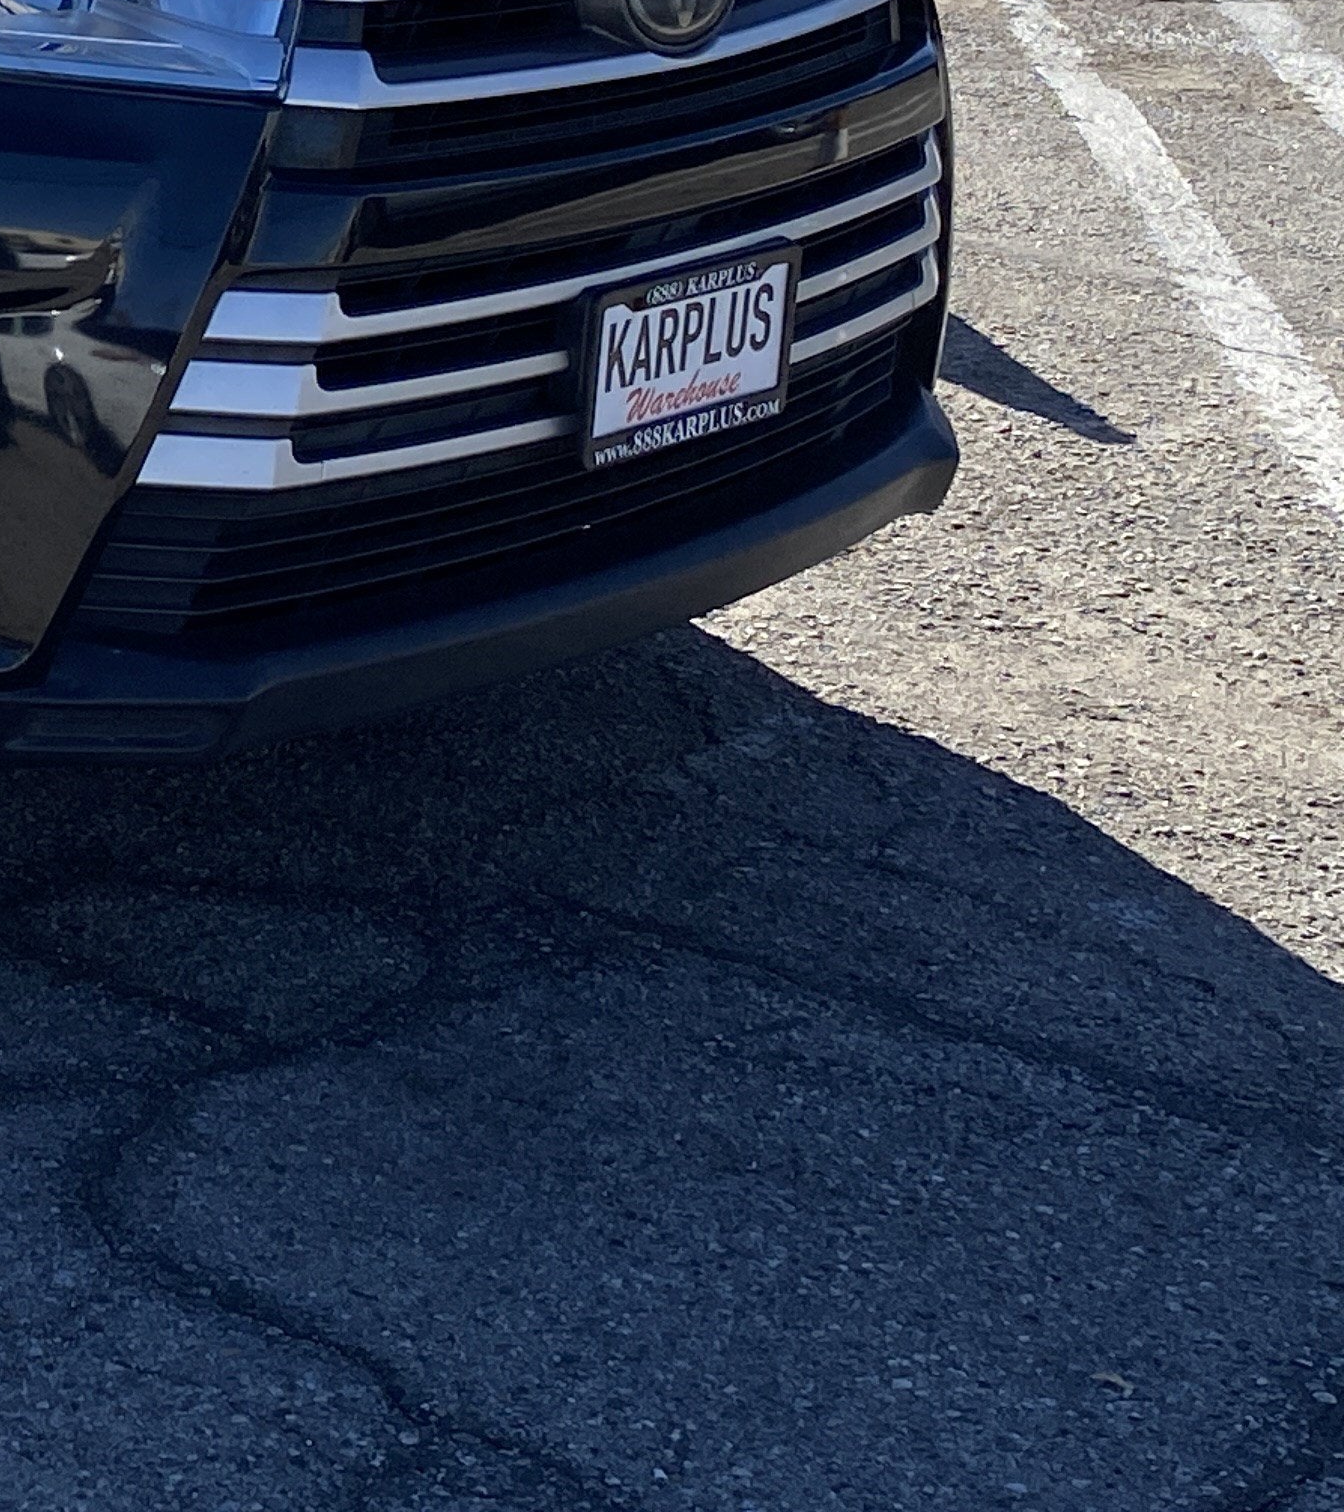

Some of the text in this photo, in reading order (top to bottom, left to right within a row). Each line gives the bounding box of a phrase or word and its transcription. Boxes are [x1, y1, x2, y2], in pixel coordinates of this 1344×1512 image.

[686, 261, 757, 296] KARPLUS
[604, 282, 775, 394] KARPLUS
[625, 369, 742, 424] Warehouse
